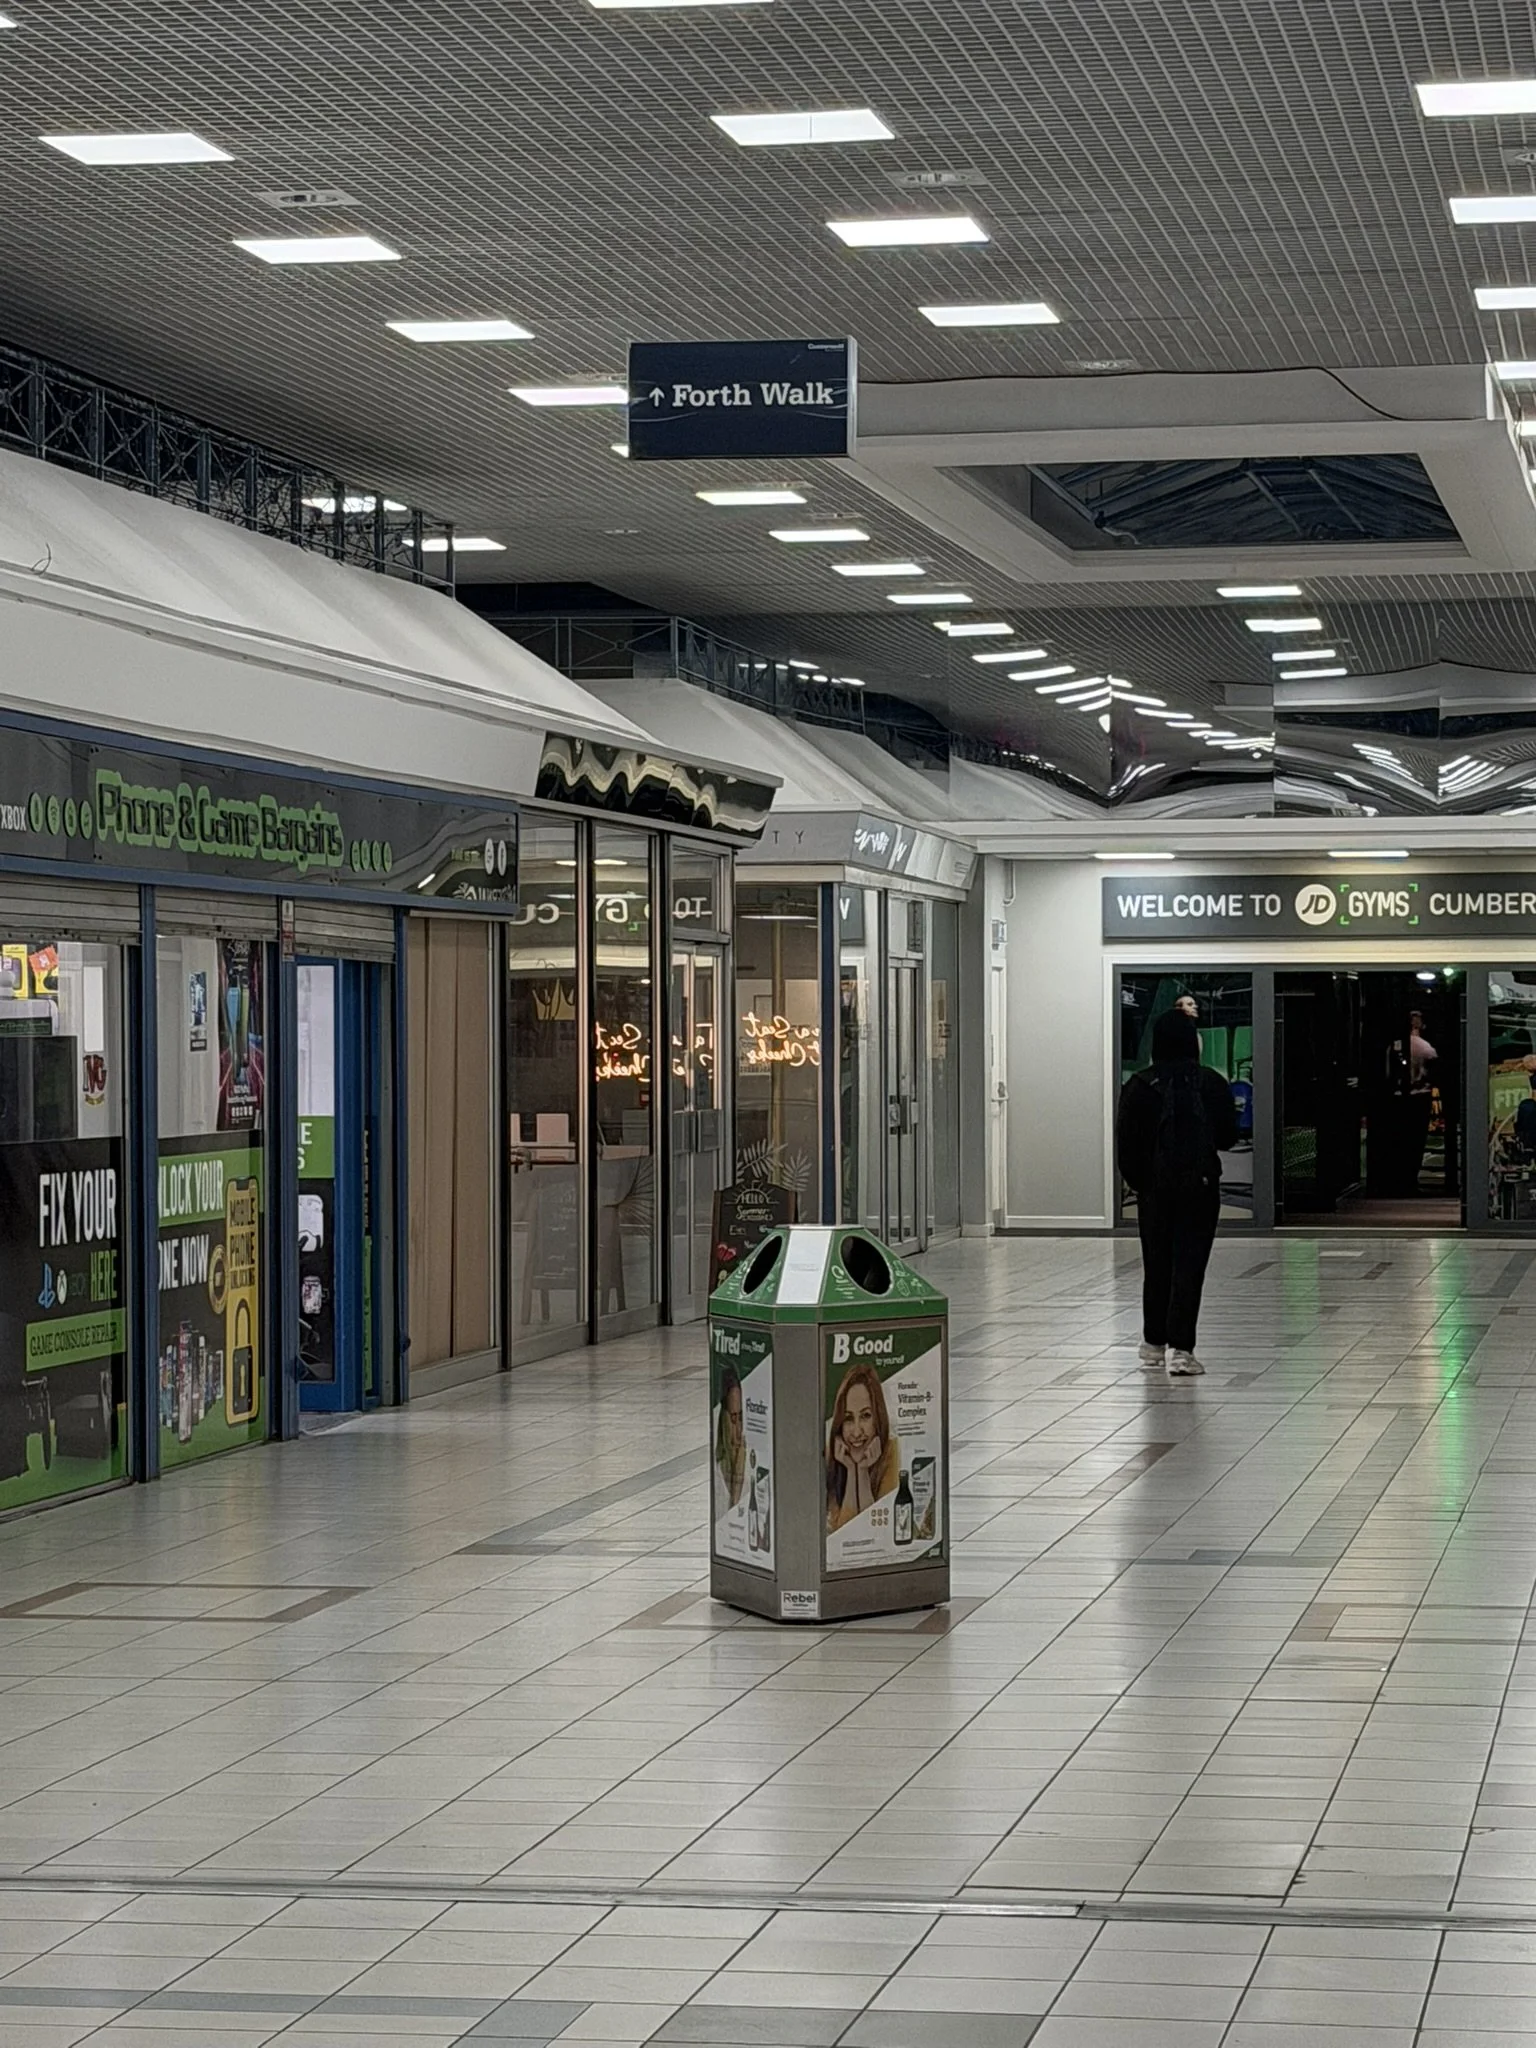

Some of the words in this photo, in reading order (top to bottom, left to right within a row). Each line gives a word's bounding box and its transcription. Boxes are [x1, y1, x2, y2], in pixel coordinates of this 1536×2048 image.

[672, 384, 752, 407] Forth
[760, 382, 834, 406] Walk
[0, 804, 27, 832] XBOX
[97, 776, 175, 843] Phone
[261, 801, 343, 865] Bargains
[1117, 894, 1244, 918] WELCOME
[1249, 894, 1281, 916] TO
[1348, 891, 1411, 917] GYMS
[1429, 892, 1536, 916] CUMBER
[194, 1159, 223, 1213] YOUR
[39, 1172, 68, 1248] FIX
[72, 1168, 117, 1244] YOUR
[182, 1234, 209, 1287] NOW
[230, 1231, 256, 1267] PHONE
[90, 1249, 118, 1302] HERE
[30, 1332, 54, 1357] GAME
[54, 1326, 91, 1353] CONSOLE
[91, 1321, 118, 1345] REPAIR
[713, 1328, 740, 1356] Tired
[832, 1333, 851, 1364] B
[853, 1334, 893, 1356] Good
[898, 1407, 928, 1420] Complex
[783, 1593, 817, 1604] Rebel
